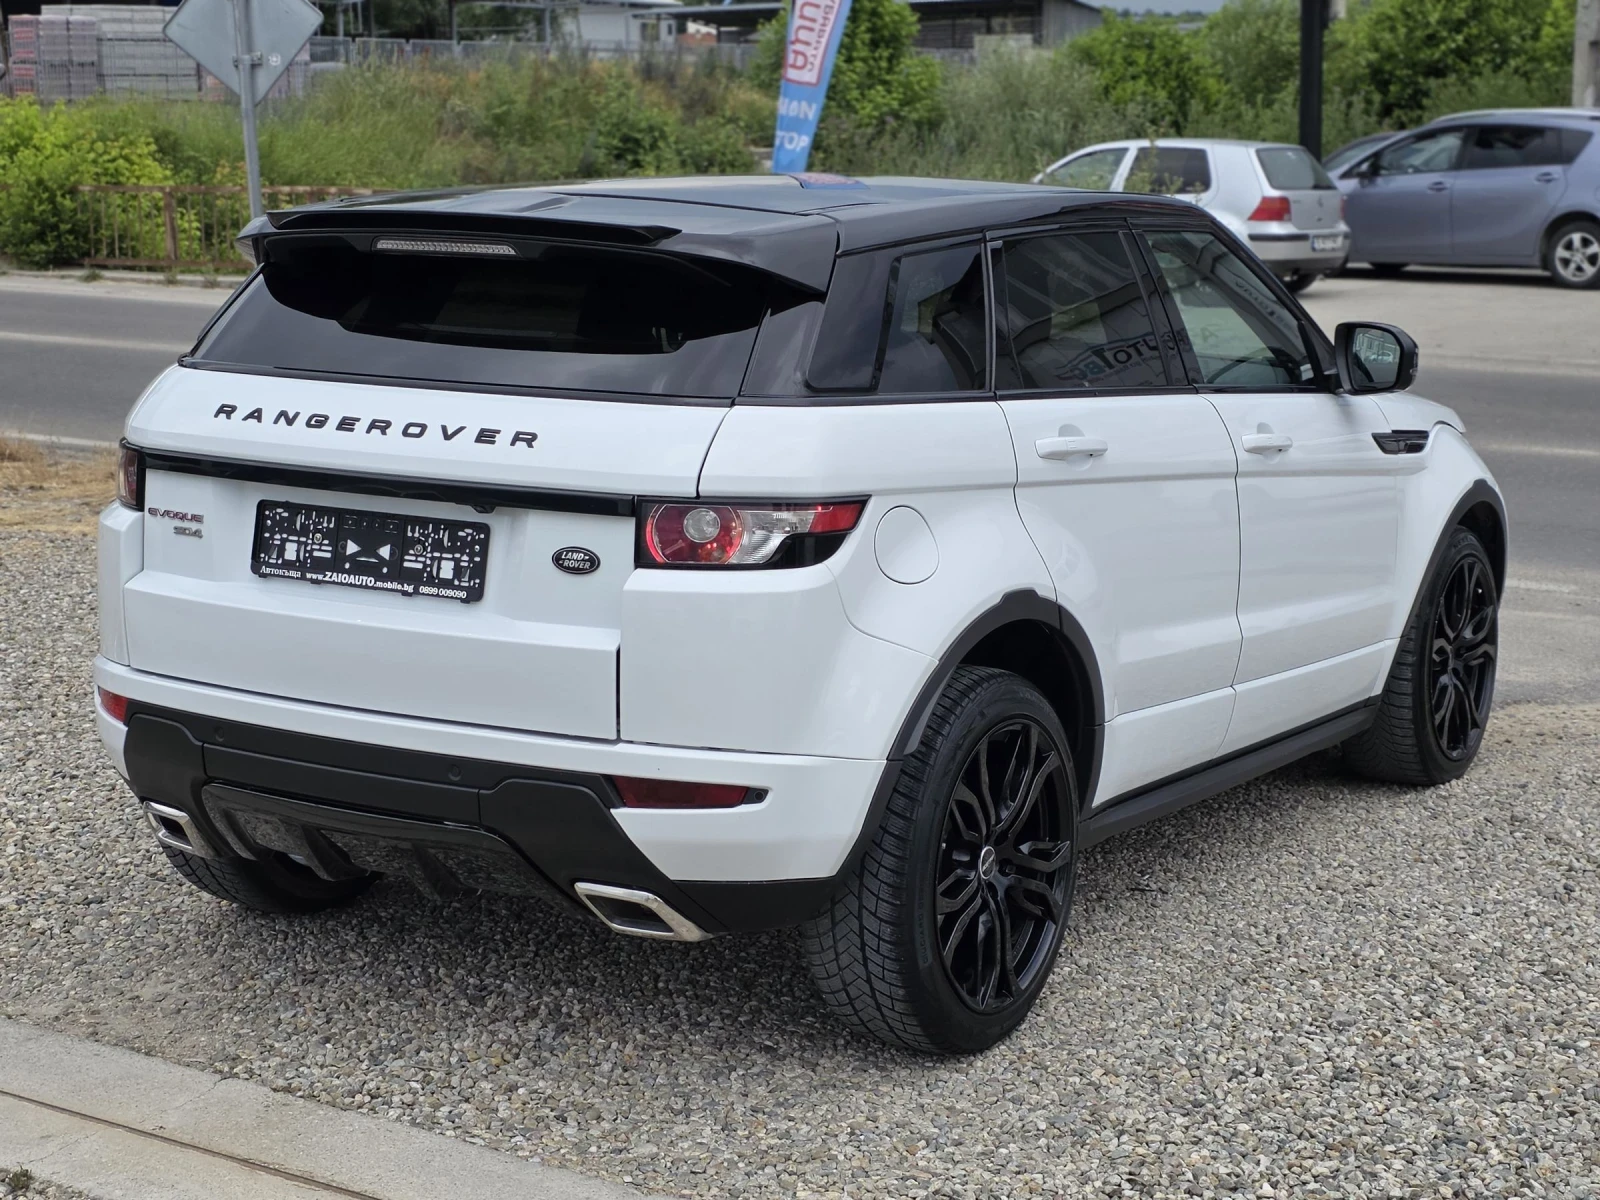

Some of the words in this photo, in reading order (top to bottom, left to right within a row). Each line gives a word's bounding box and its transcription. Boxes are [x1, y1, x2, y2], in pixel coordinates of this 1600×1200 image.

[148, 507, 204, 524] EVOQUE
[563, 560, 591, 569] ROVER
[260, 565, 301, 578] Автокъща
[419, 585, 438, 595] 0899
[438, 587, 467, 599] 009090
